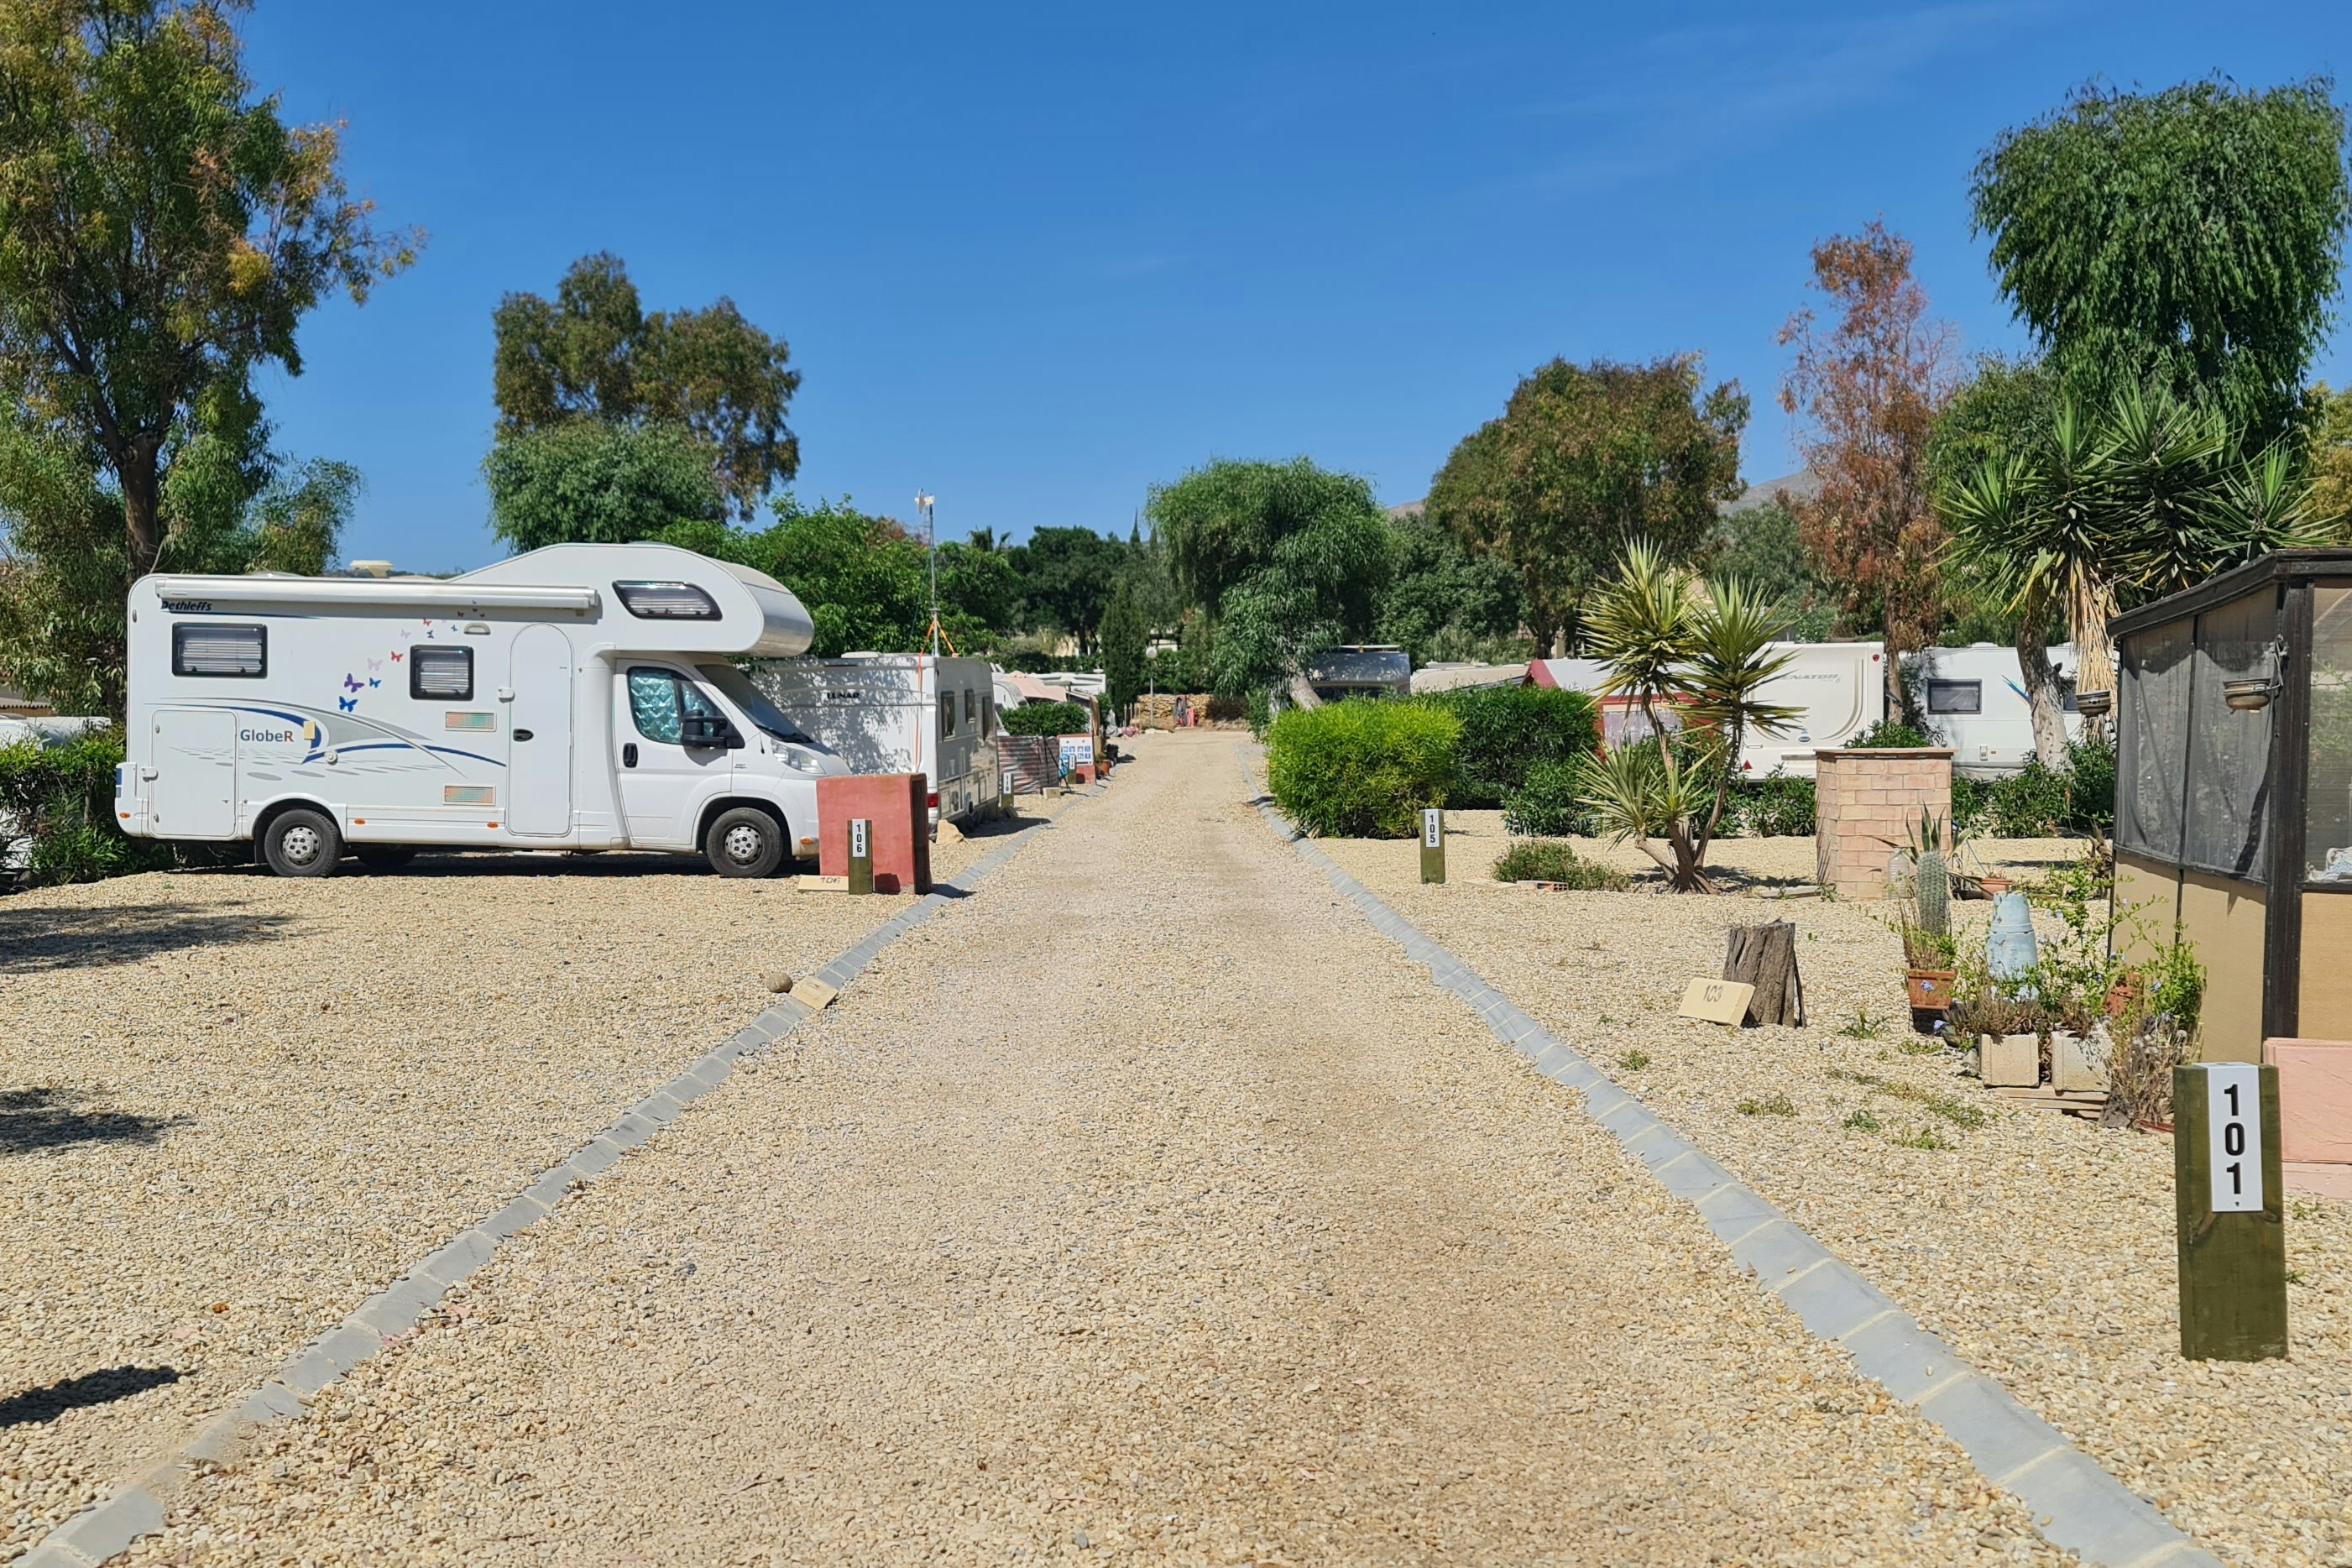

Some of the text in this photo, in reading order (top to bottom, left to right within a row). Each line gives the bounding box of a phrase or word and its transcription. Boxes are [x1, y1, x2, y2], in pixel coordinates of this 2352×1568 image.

[161, 601, 212, 611] Dethleffs
[240, 729, 294, 742] GlobeR
[1703, 984, 1725, 1002] 103
[2224, 1084, 2245, 1194] 101
